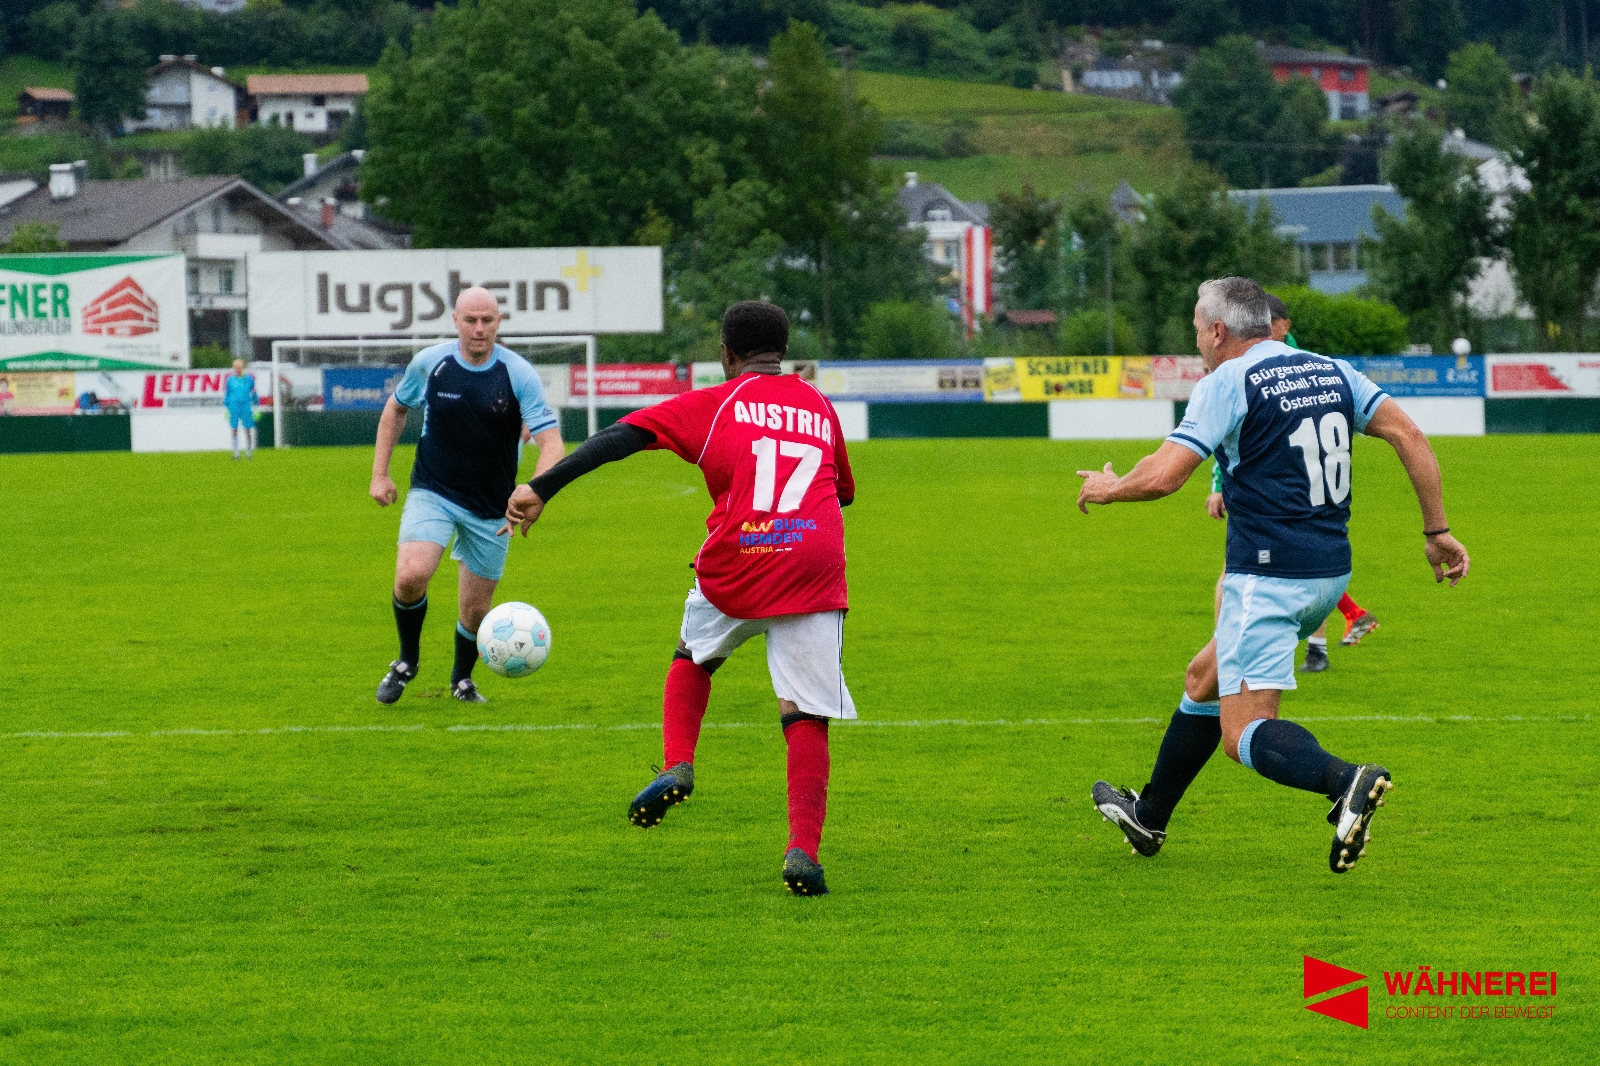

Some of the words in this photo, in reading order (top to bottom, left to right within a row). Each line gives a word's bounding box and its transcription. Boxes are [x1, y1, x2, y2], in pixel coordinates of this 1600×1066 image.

[1249, 360, 1335, 386] Bürgermeister
[142, 373, 254, 408] LEITN
[1260, 375, 1343, 400] Fußball-Team
[1280, 390, 1342, 412] Österreich
[734, 400, 831, 446] AUSTRIA
[1288, 411, 1352, 507] 18
[751, 436, 823, 513] 17
[739, 531, 803, 546] HEMDEN
[739, 546, 774, 554] AUSTRIA
